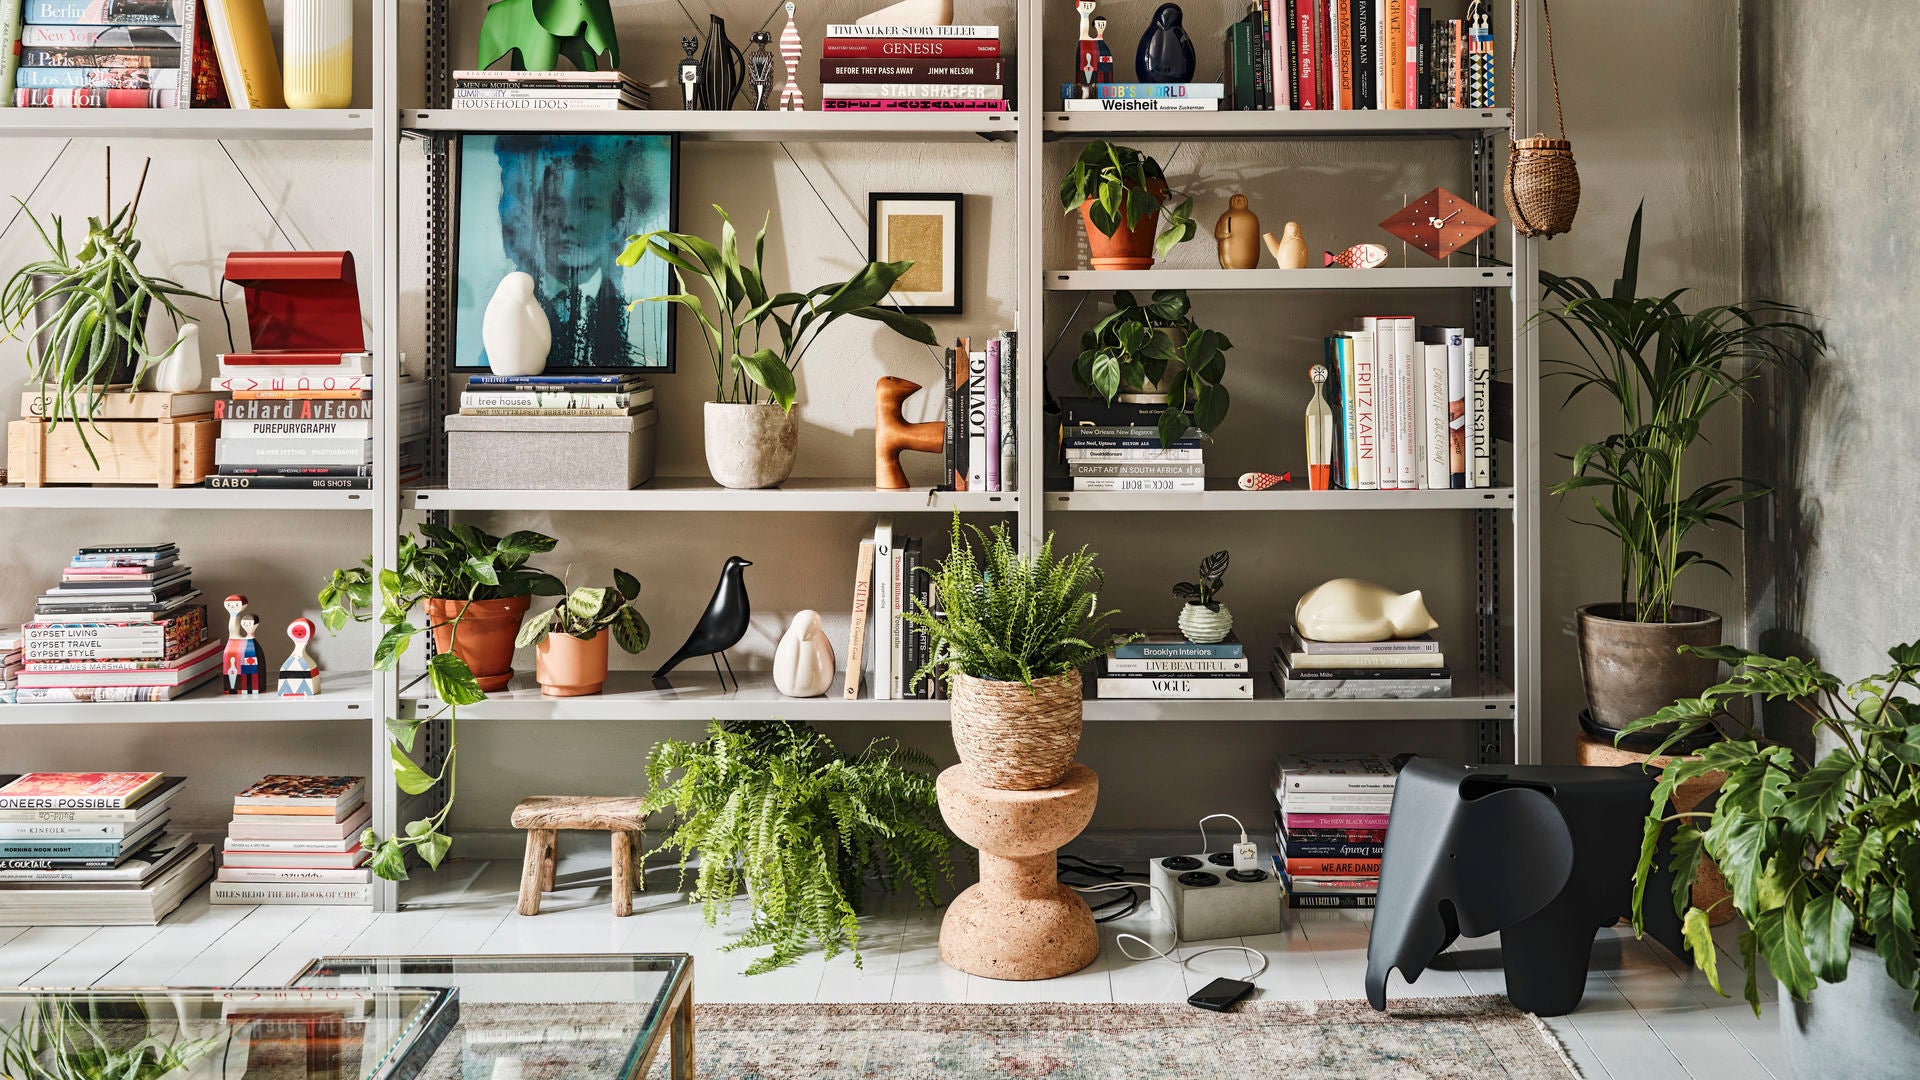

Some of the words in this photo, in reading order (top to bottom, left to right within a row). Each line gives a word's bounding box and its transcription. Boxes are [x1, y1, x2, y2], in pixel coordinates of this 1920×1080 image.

[39, 3, 86, 18] Berlin
[1359, 0, 1367, 43] FANTASTIC
[1390, 0, 1400, 34] GRACE
[37, 29, 66, 42] New
[67, 29, 98, 42] York
[833, 25, 851, 35] TIM
[853, 25, 899, 36] WALKER
[901, 26, 934, 36] STORY
[936, 26, 976, 36] TELLER
[1301, 14, 1310, 55] Fashionable
[184, 22, 193, 55] DAGMAR
[882, 42, 943, 55] GENESIS
[38, 51, 75, 67] Paris
[183, 56, 191, 73] VON
[835, 66, 859, 75] BEFORE
[861, 66, 877, 75] THEY
[878, 66, 895, 75] PASS
[896, 66, 914, 75] AWAY
[927, 66, 948, 75] JIMMY
[949, 66, 974, 75] NELSON
[1301, 57, 1310, 79] Selby
[32, 71, 59, 86] Los
[181, 73, 189, 96] TAUBE
[880, 84, 918, 97] STAN
[921, 84, 985, 98] SHAFFER
[31, 90, 101, 106] London
[456, 99, 530, 110] HOUSEHOLD
[533, 99, 568, 110] IDOLS
[824, 100, 881, 109] HOTEL
[886, 100, 998, 110] LACHAPELLE
[1102, 99, 1158, 111] Weisheit
[221, 377, 361, 391] AVEDON
[1357, 362, 1373, 408] FRITZ
[478, 397, 497, 406] tree
[500, 394, 532, 406] houses
[970, 359, 985, 438] LOVING
[1474, 368, 1490, 459] Streisand
[253, 423, 337, 434] PUREPURYGRAPHY
[1130, 428, 1153, 436] Elegance
[1359, 412, 1374, 459] KAHN
[1098, 440, 1116, 448] Uptown
[1078, 466, 1102, 474] CRAFT
[1103, 466, 1119, 474] ART
[1119, 466, 1128, 474] IN
[1129, 466, 1155, 474] SOUTH
[1156, 466, 1183, 474] AFRICA
[211, 478, 250, 488] GABO
[312, 479, 326, 487] BIG
[327, 479, 352, 487] SHOTS
[1121, 480, 1142, 490] BOAT
[1152, 480, 1174, 490] ROCK
[854, 581, 868, 613] KILIM
[894, 582, 902, 610] Billhardt
[30, 630, 66, 638] GYPSET
[68, 630, 98, 638] LIVING
[894, 615, 902, 649] Fotografie
[30, 641, 65, 649] GYPSET
[67, 640, 101, 648] TRAVEL
[30, 650, 65, 658] GYPSET
[1143, 648, 1178, 658] Brooklyn
[1179, 648, 1212, 656] Interiors
[89, 663, 134, 671] MARSHALL
[1146, 661, 1170, 671] LIVE
[1170, 661, 1227, 671] BEAUTIFUL
[1151, 680, 1190, 692] VOGUE
[58, 798, 121, 808] POSSIBLE
[39, 811, 75, 821] Build-On
[1339, 844, 1370, 857] Dandy
[1321, 863, 1333, 872] WE
[1335, 863, 1352, 872] ARE
[1354, 863, 1381, 872] DAND
[215, 890, 241, 898] MILES
